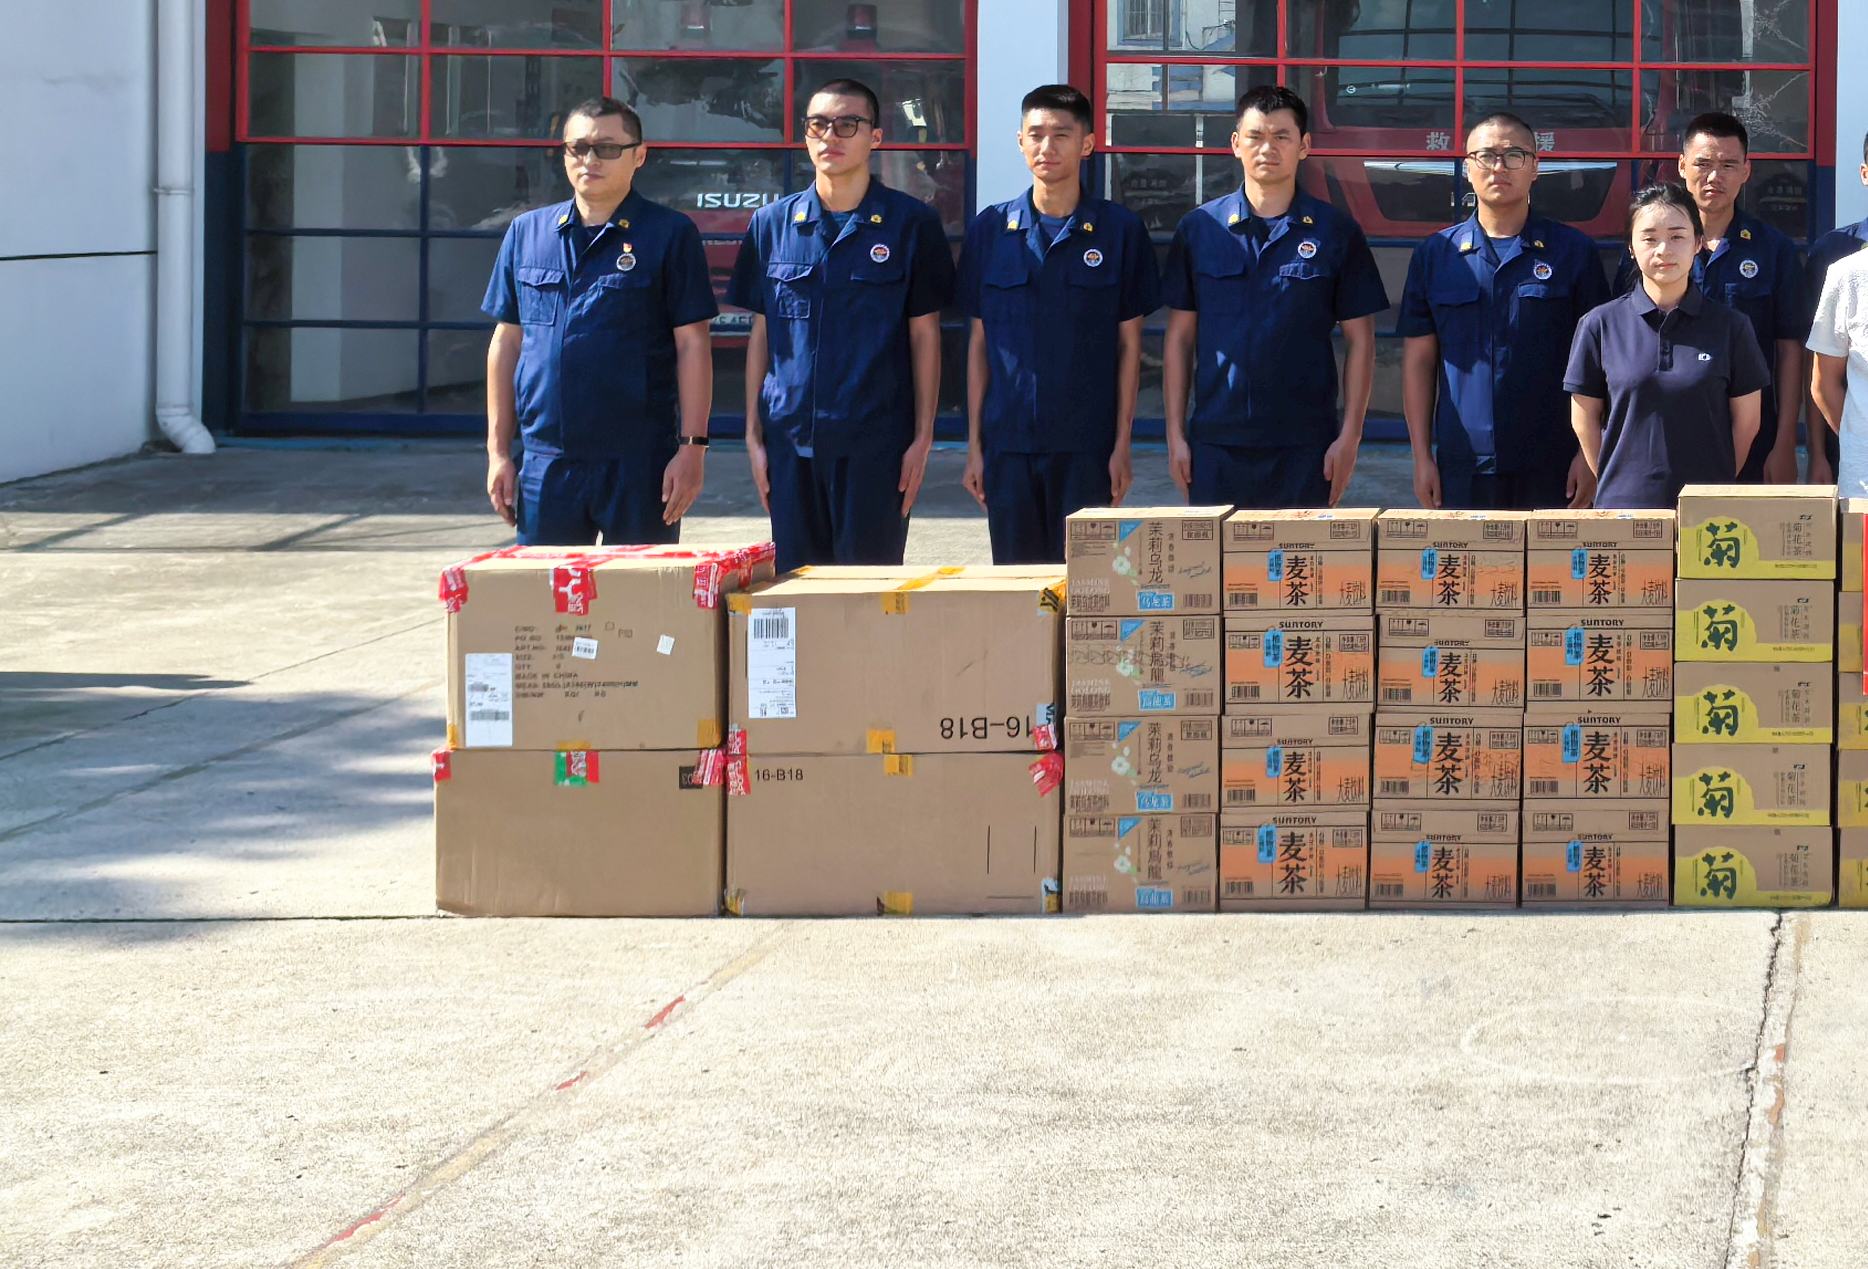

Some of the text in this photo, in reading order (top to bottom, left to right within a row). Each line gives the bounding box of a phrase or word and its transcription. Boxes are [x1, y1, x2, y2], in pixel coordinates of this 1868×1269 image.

[1704, 521, 1740, 568] 菊
[1285, 555, 1308, 606] 麦茶
[1438, 554, 1461, 606] 麦茶
[1589, 554, 1611, 605] 麦茶
[1279, 620, 1323, 629] SUNTORY
[1701, 604, 1738, 652] 菊
[1285, 636, 1315, 698] 麦茶
[1439, 652, 1463, 703] 麦茶
[1587, 633, 1614, 697] 麦茶
[940, 715, 1032, 739] 16-B18
[1430, 717, 1474, 725] SUNTORY
[1578, 716, 1621, 724] SUNTORY
[1702, 689, 1739, 737] 菊
[755, 769, 803, 781] 16-B18
[1283, 751, 1307, 803] 麦茶
[1434, 731, 1464, 795] 麦茶
[1584, 731, 1612, 794] 麦茶
[1272, 816, 1317, 824] SUNTORY
[1698, 771, 1734, 819] 菊
[1279, 831, 1308, 894] 麦茶
[1433, 846, 1453, 899] 麦茶
[1584, 846, 1606, 898] 麦茶
[1700, 852, 1737, 899] 菊
